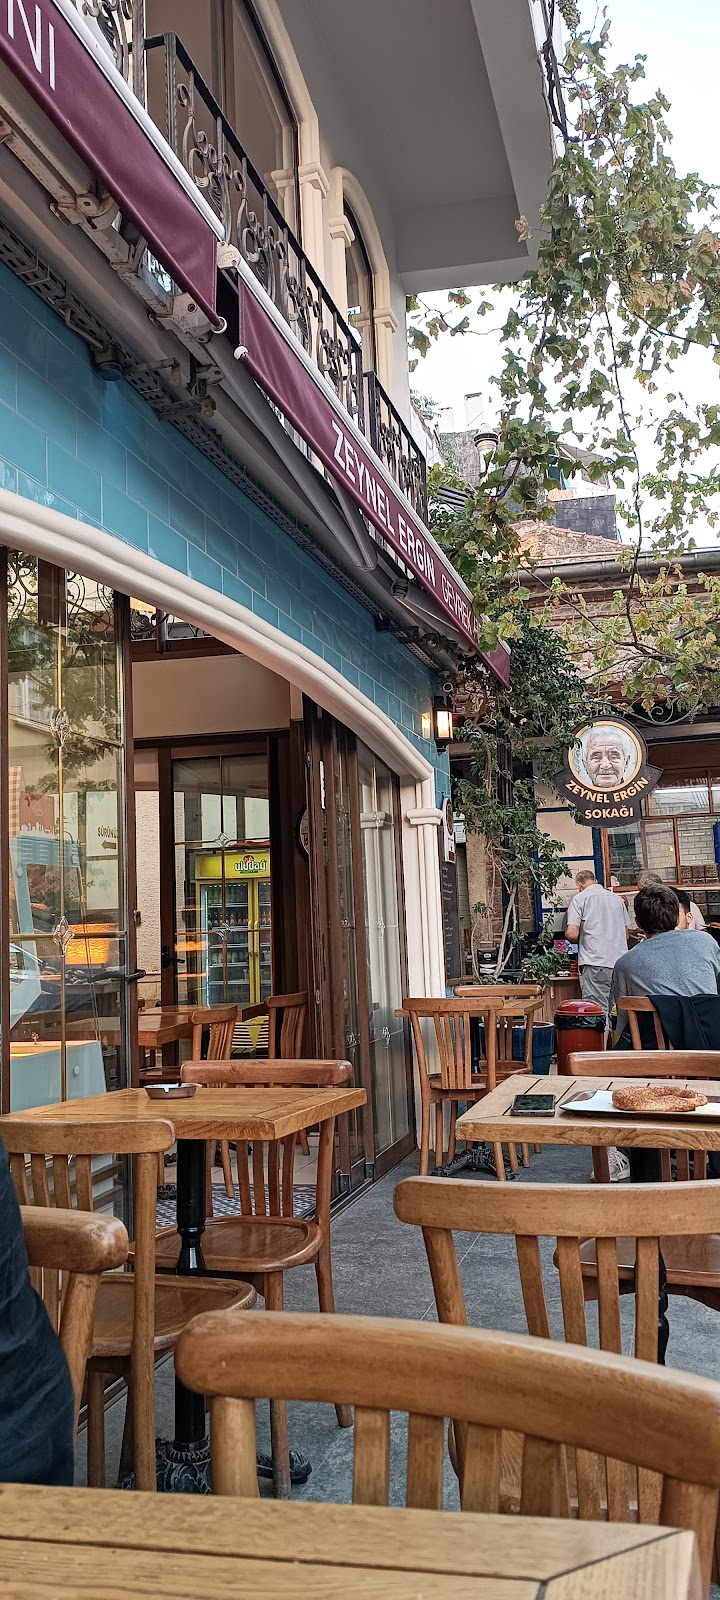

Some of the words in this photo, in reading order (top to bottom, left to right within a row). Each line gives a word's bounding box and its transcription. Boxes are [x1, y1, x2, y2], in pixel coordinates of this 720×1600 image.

[331, 419, 396, 537] ZEYNEL
[398, 513, 436, 588] ERGİN
[441, 573, 473, 636] GEVREK
[565, 780, 610, 804] ZEYNEL
[613, 776, 650, 802] ERGİN
[585, 805, 634, 819] SOKAĞI
